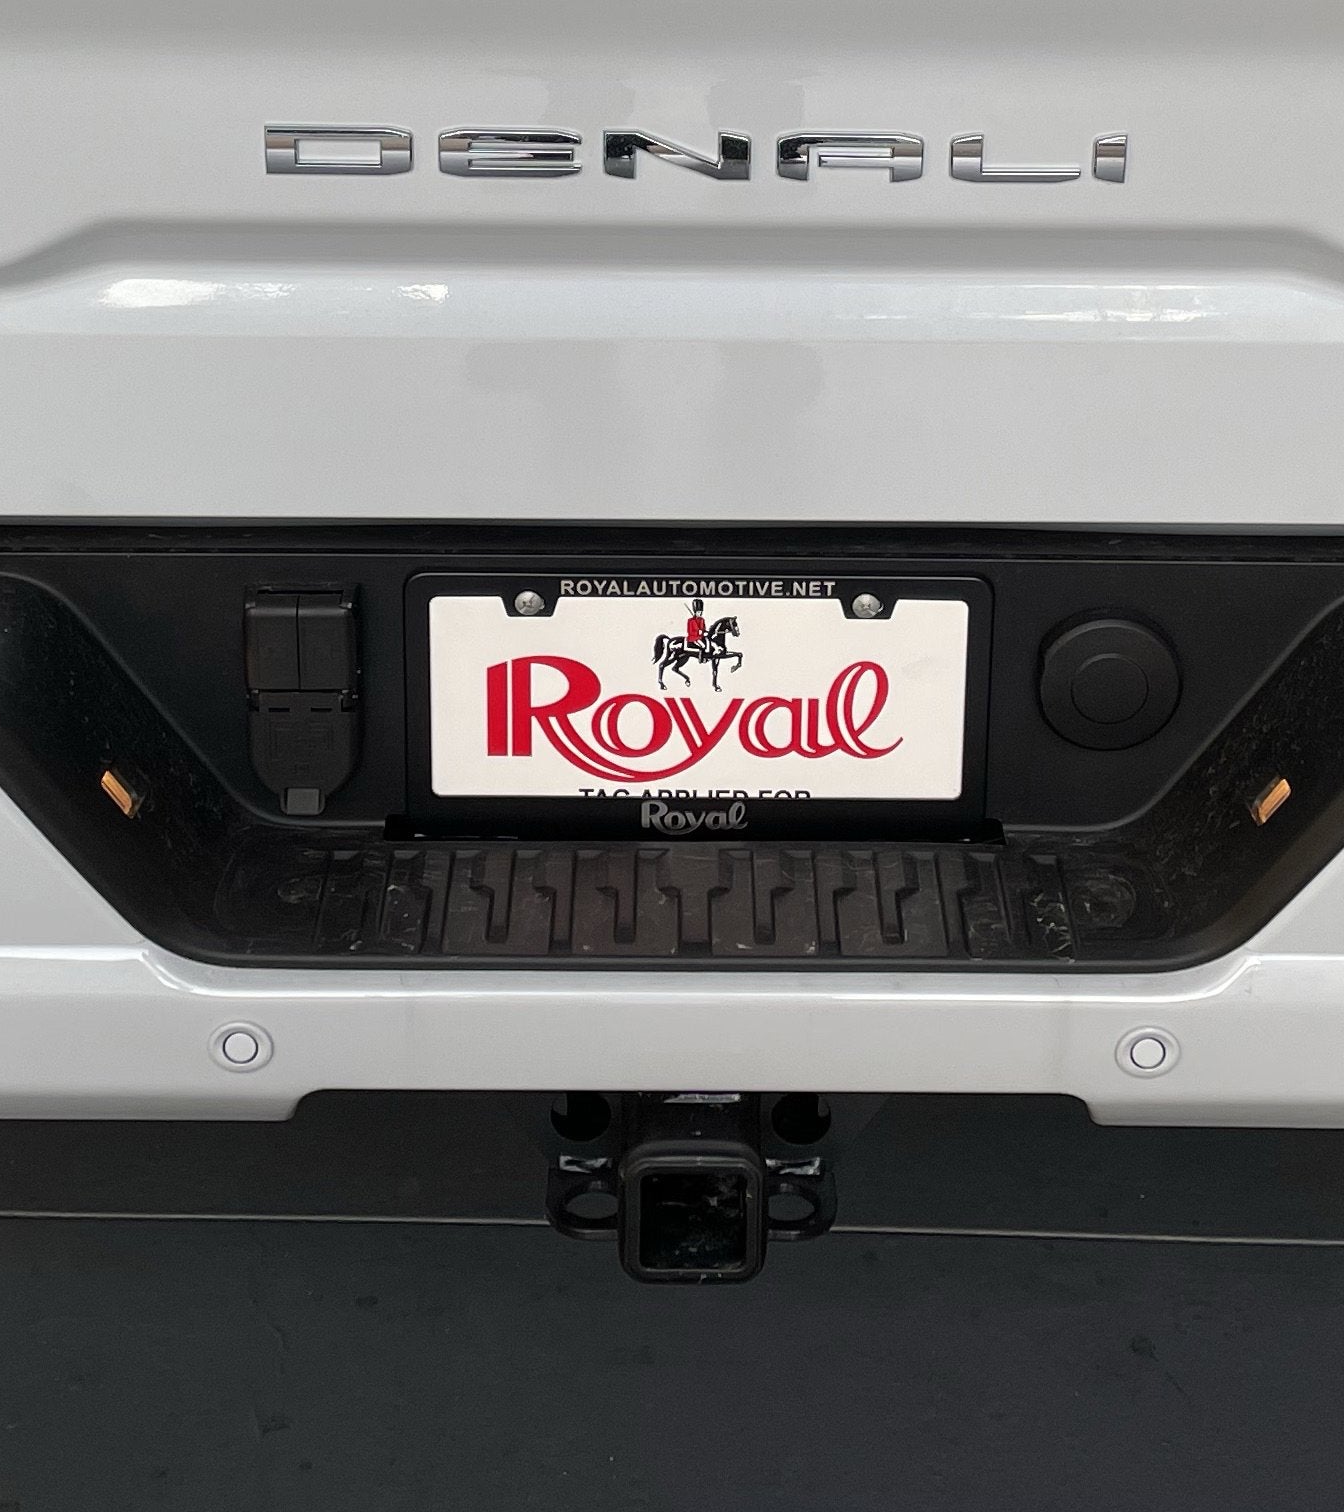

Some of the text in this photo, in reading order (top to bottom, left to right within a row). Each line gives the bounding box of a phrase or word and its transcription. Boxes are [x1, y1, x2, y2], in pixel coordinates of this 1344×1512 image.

[264, 125, 1128, 183] DENALI
[559, 579, 836, 597] ROYALAUTOMOTIVE.NET
[486, 655, 904, 783] Royal
[641, 800, 749, 836] Royal
